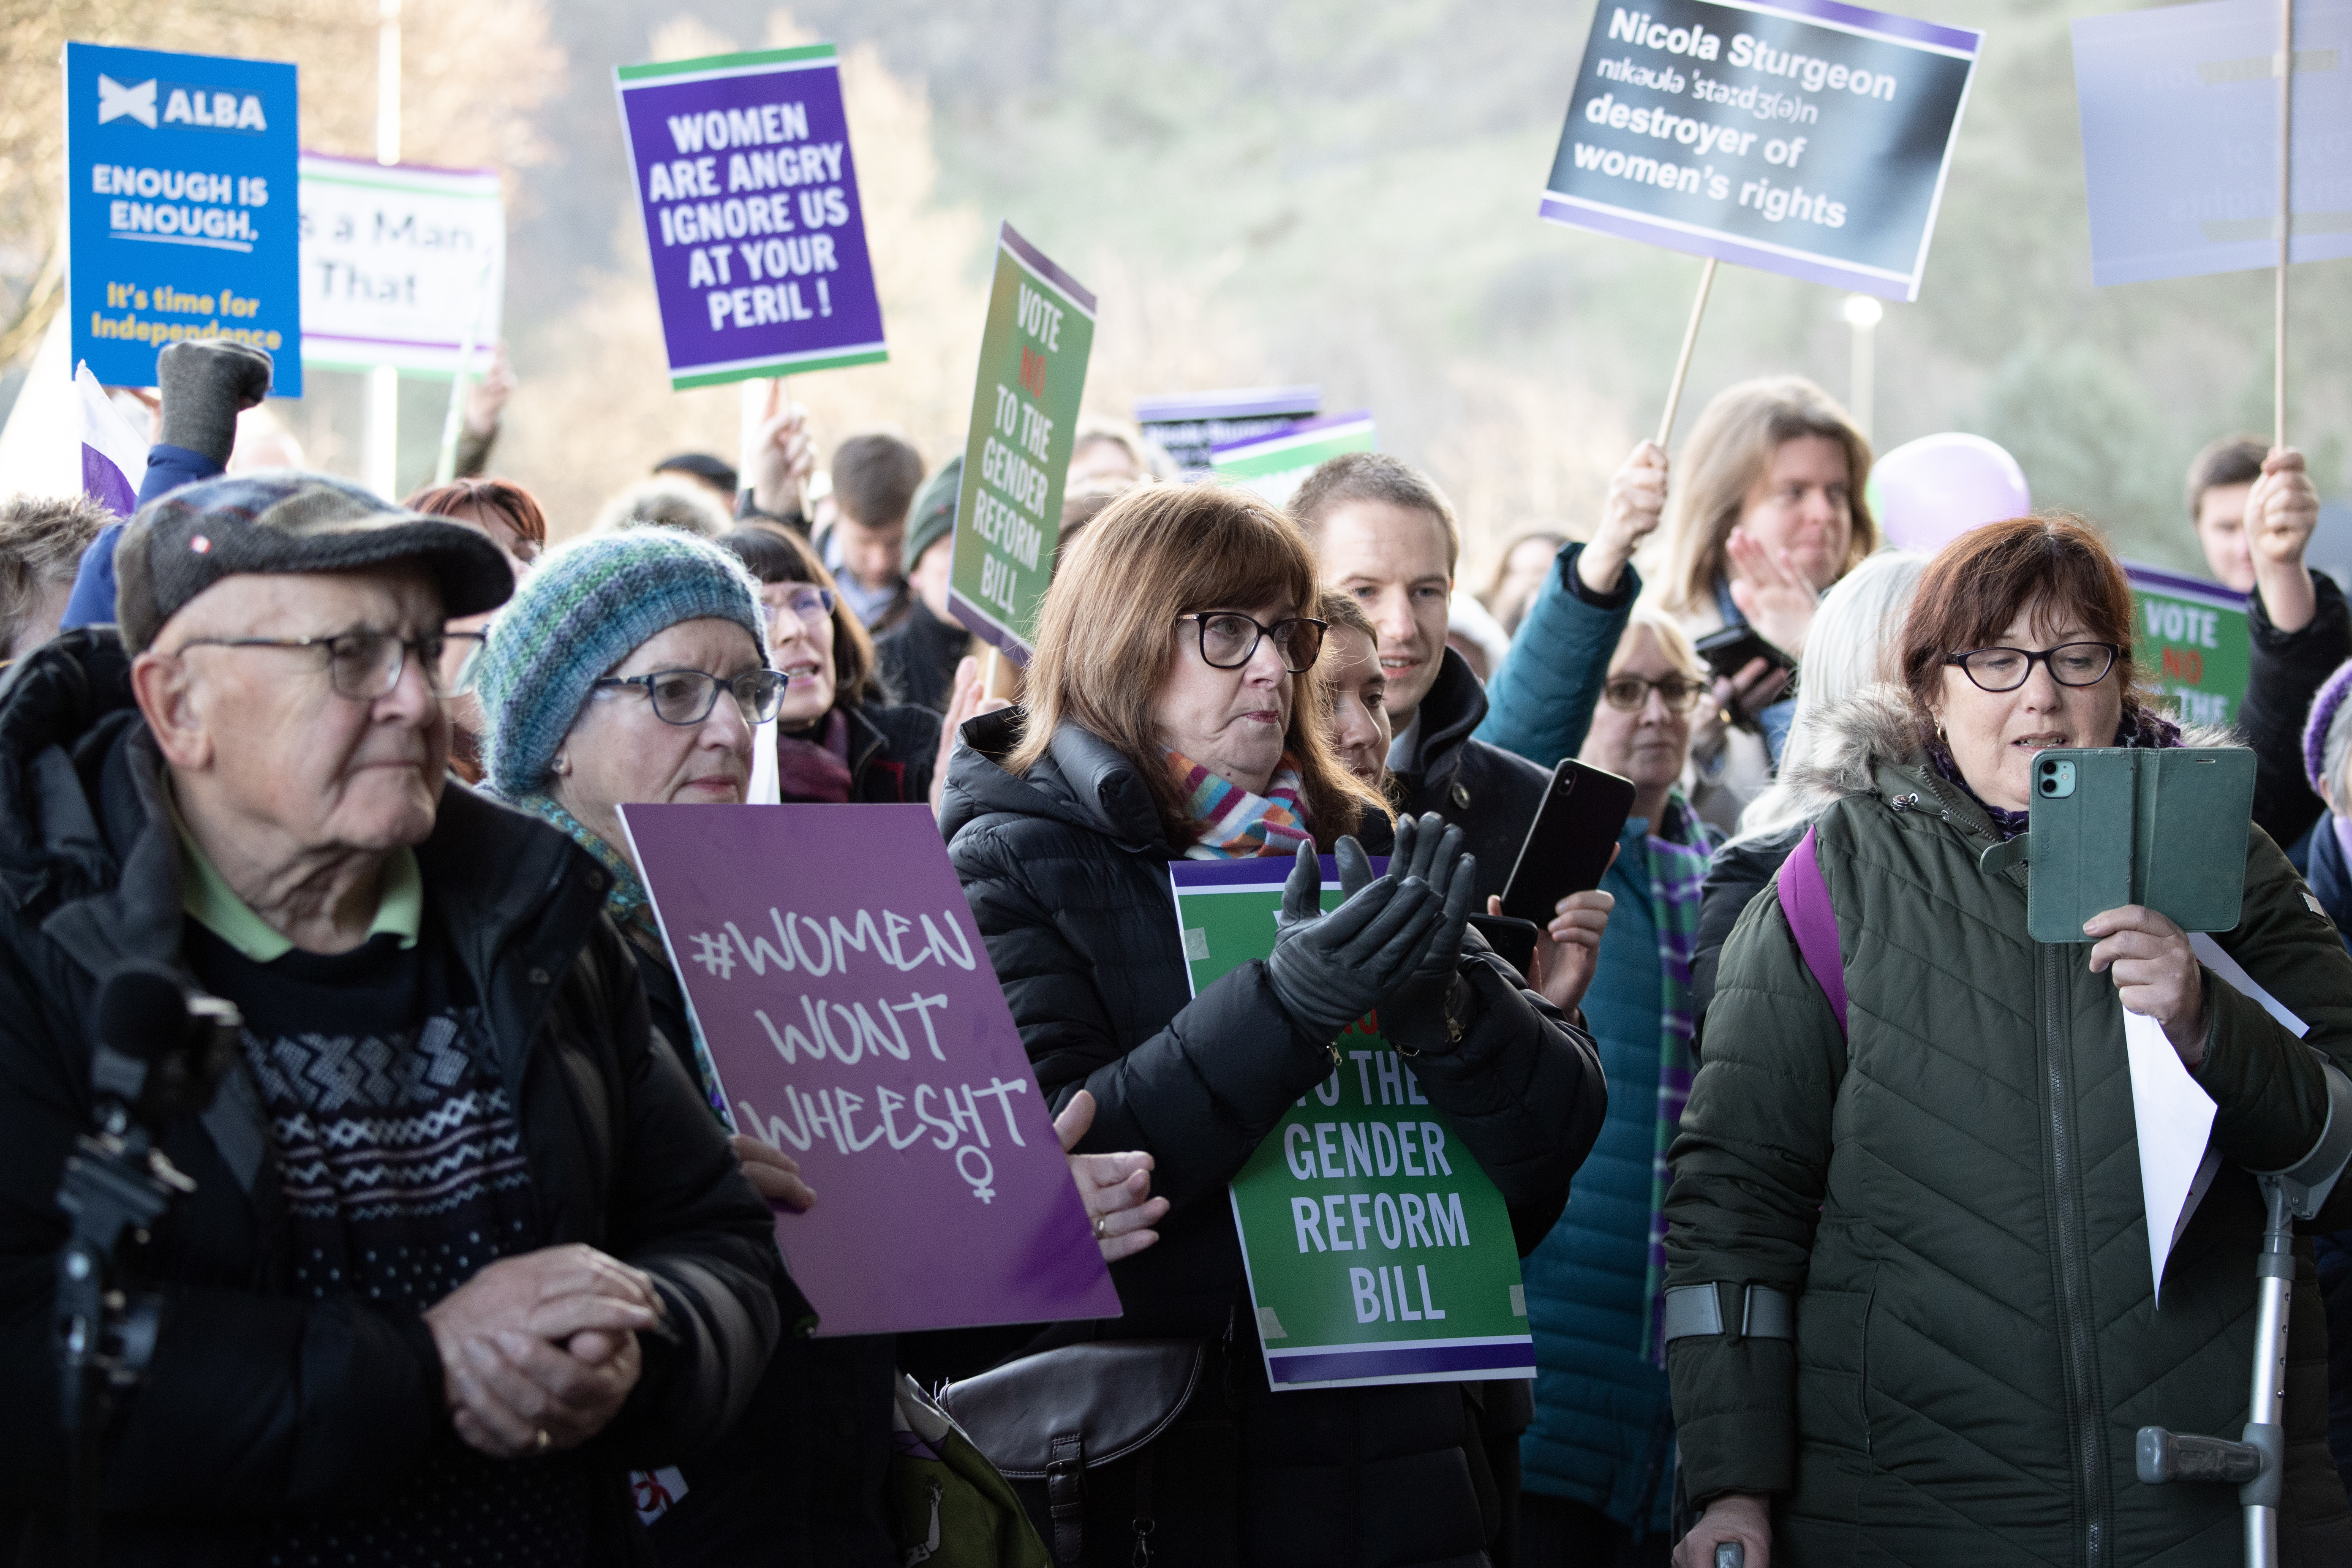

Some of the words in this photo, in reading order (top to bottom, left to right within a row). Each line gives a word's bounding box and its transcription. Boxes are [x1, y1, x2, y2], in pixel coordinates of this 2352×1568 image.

[1607, 7, 1720, 61] Nicola
[1726, 33, 1896, 100] Sturgeon
[163, 88, 267, 131] ALBA
[667, 101, 810, 154] WOMEN
[1584, 93, 1757, 156] destroyer
[1763, 136, 1807, 168] of
[92, 163, 232, 203] ENOUGH
[239, 175, 269, 207] IS
[648, 156, 721, 203] ARE
[727, 141, 844, 193] ANGRY
[1573, 141, 1730, 201] women's
[1738, 177, 1847, 229] rights
[109, 200, 259, 241] ENOUGH.
[373, 210, 474, 250] Man
[659, 192, 795, 247] IGNORE
[798, 186, 849, 229] US
[315, 256, 416, 306] That
[689, 245, 733, 289] AT
[739, 233, 839, 281] YOUR
[107, 281, 148, 310] It's
[153, 285, 215, 315] time
[220, 289, 260, 318] for
[1017, 282, 1063, 352] VOTE
[1019, 344, 1046, 398] NO
[996, 383, 1018, 436] TO
[1021, 401, 1053, 463] THE
[982, 436, 1048, 520] GENDER
[972, 488, 1043, 572] REFORM
[980, 553, 1015, 615] BILL
[2144, 600, 2219, 649] VOTE
[2161, 646, 2204, 686] NO
[689, 907, 976, 980] #WOMEN
[754, 992, 948, 1065] WONT
[738, 1077, 1027, 1155] WHEESHT
[1284, 1122, 1453, 1179] GENDER
[1291, 1192, 1470, 1253] REFORM
[1349, 1264, 1446, 1323] BILL
